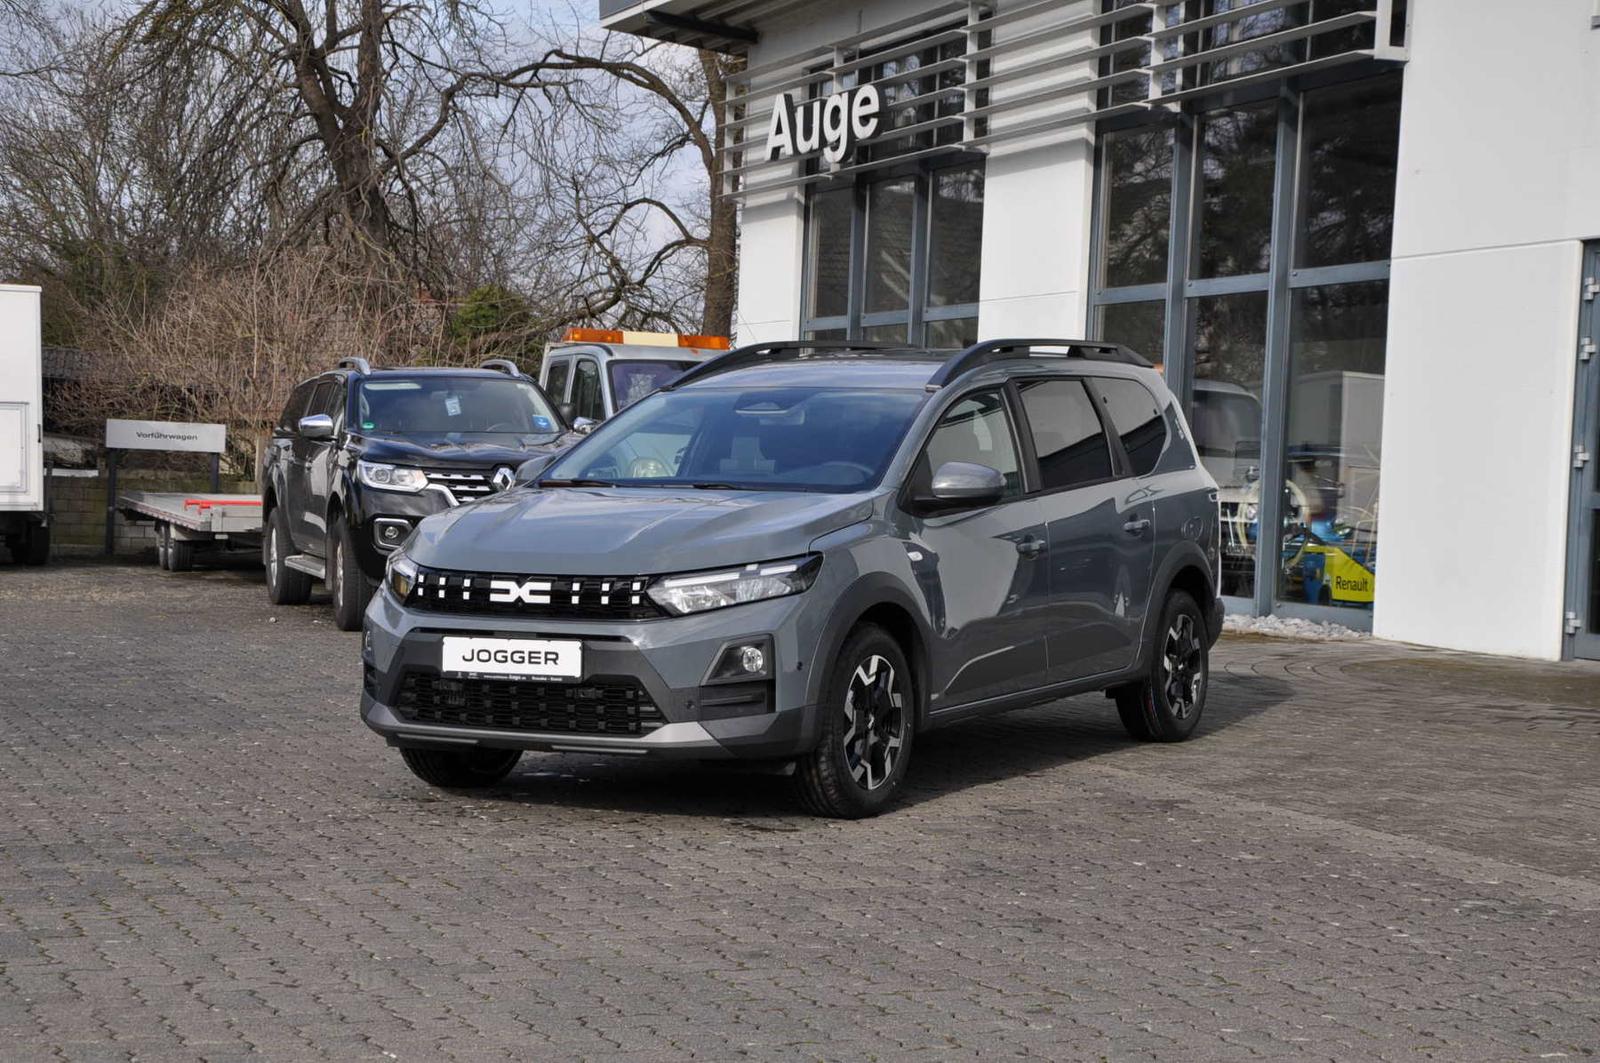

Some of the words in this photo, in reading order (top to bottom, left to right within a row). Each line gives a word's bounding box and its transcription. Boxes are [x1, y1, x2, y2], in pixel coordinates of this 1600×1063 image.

[765, 84, 880, 163] Auge
[136, 431, 198, 442] Vorführwagen
[1335, 576, 1369, 592] Renault
[462, 648, 560, 666] JOGGER
